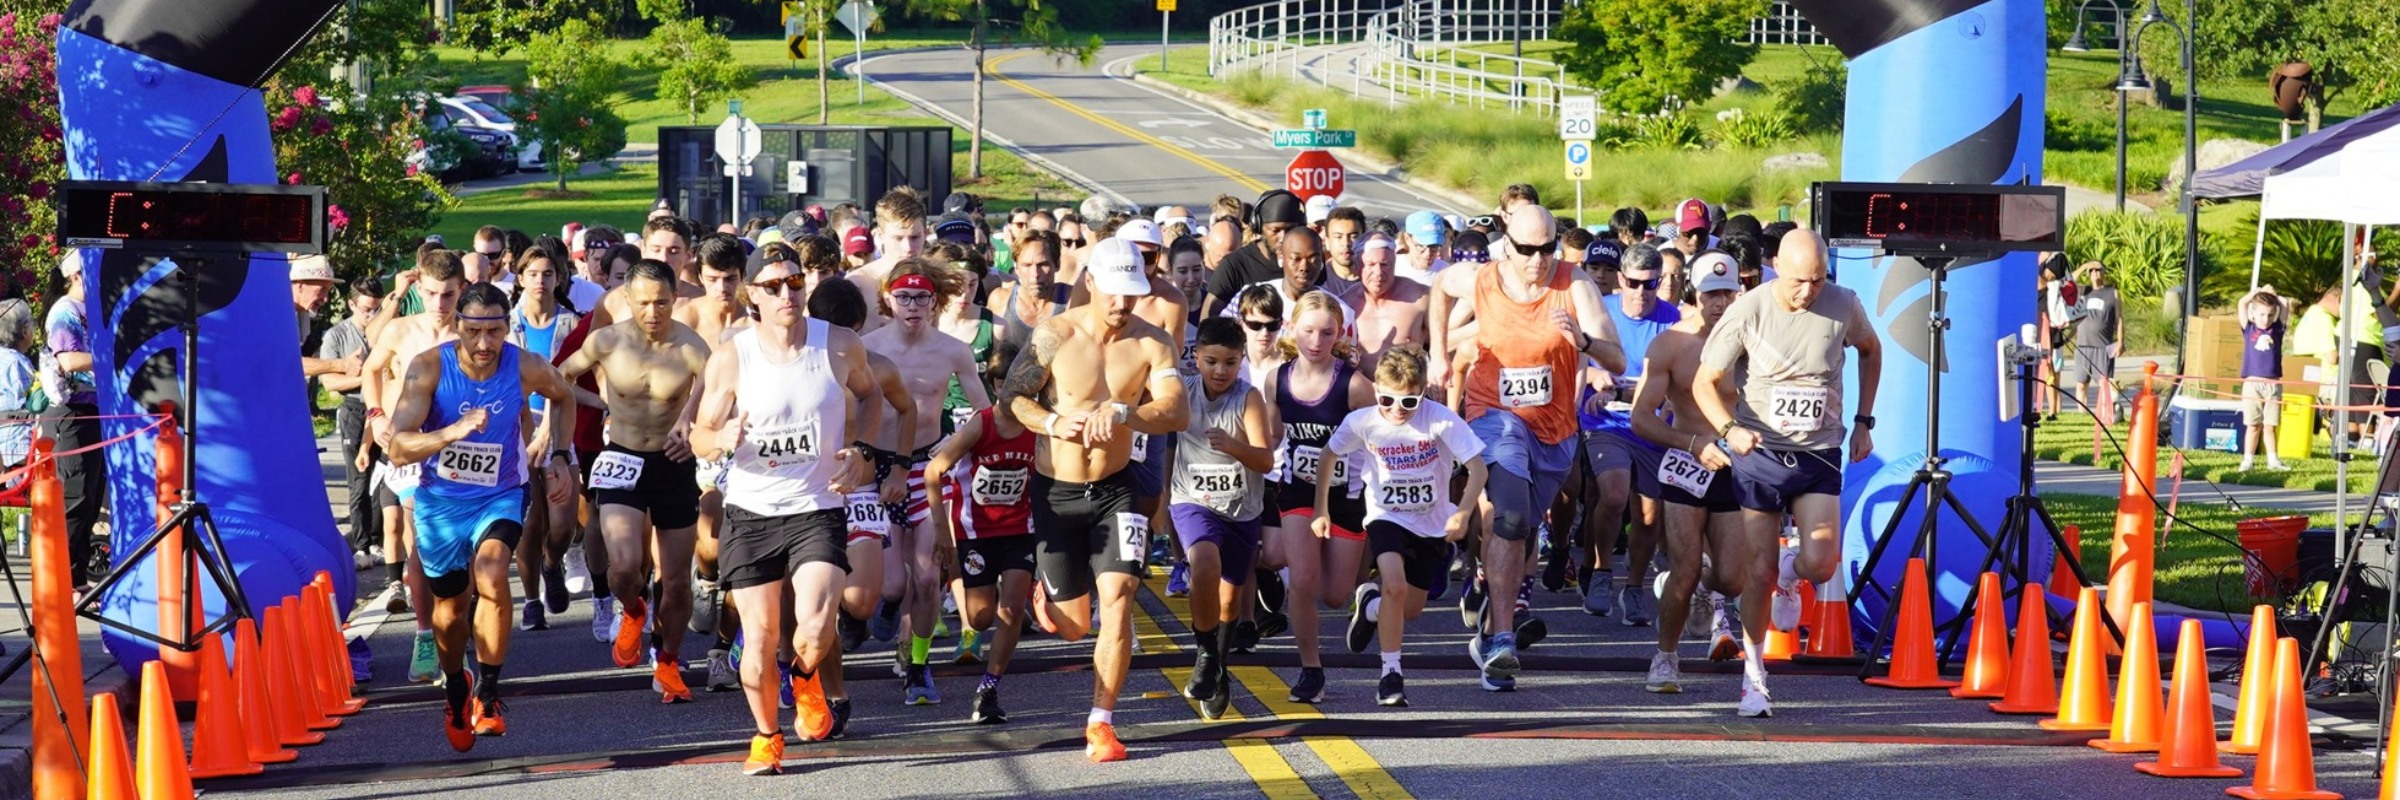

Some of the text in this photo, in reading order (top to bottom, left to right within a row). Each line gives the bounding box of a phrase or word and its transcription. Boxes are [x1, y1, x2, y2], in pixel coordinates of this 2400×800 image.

[1565, 118, 1591, 134] 20
[1276, 131, 1311, 147] Myers
[1315, 131, 1342, 144] Park
[1290, 168, 1341, 190] STOP
[1503, 377, 1550, 396] 2394
[1775, 398, 1823, 418] 2426
[757, 434, 811, 457] 2444
[443, 450, 497, 474] 2662
[1297, 456, 1345, 477] 259
[1385, 448, 1438, 465] STARS AND
[592, 460, 637, 481] 2323
[1664, 455, 1710, 485] 2678
[976, 478, 1024, 495] 2652
[1193, 474, 1243, 492] 2584
[1383, 484, 1433, 504] 2583
[847, 503, 885, 523] 2687
